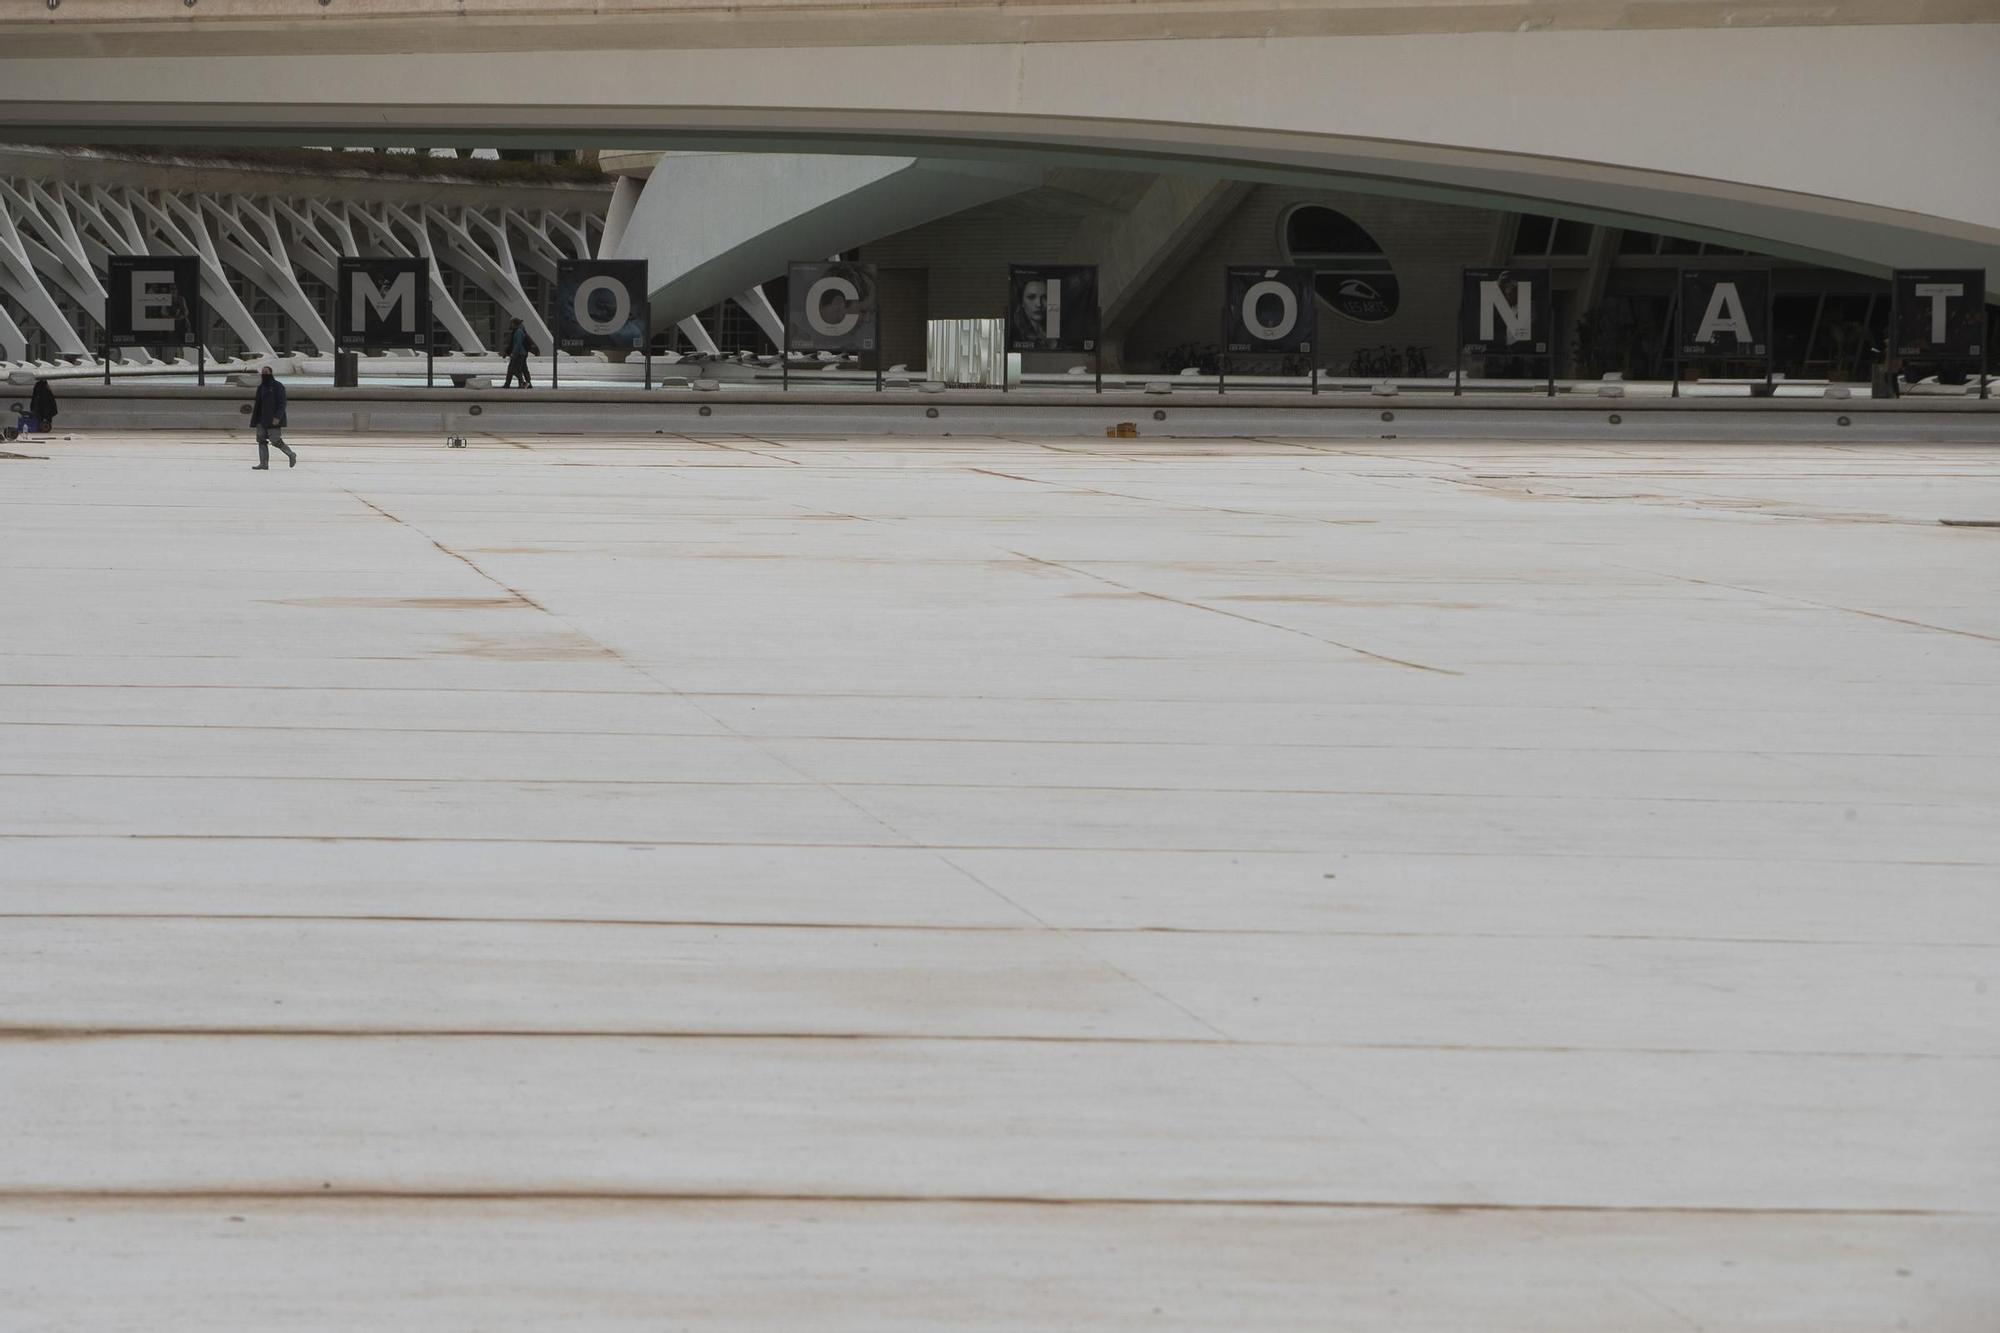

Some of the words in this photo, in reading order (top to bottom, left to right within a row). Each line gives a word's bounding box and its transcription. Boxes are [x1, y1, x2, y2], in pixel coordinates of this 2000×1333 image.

[131, 270, 175, 331] E
[352, 271, 415, 332] M
[574, 275, 631, 335] O
[806, 276, 860, 336] C
[1046, 279, 1061, 338] I
[1480, 281, 1532, 340] N
[1695, 282, 1753, 342] A
[1915, 283, 1964, 343] T
